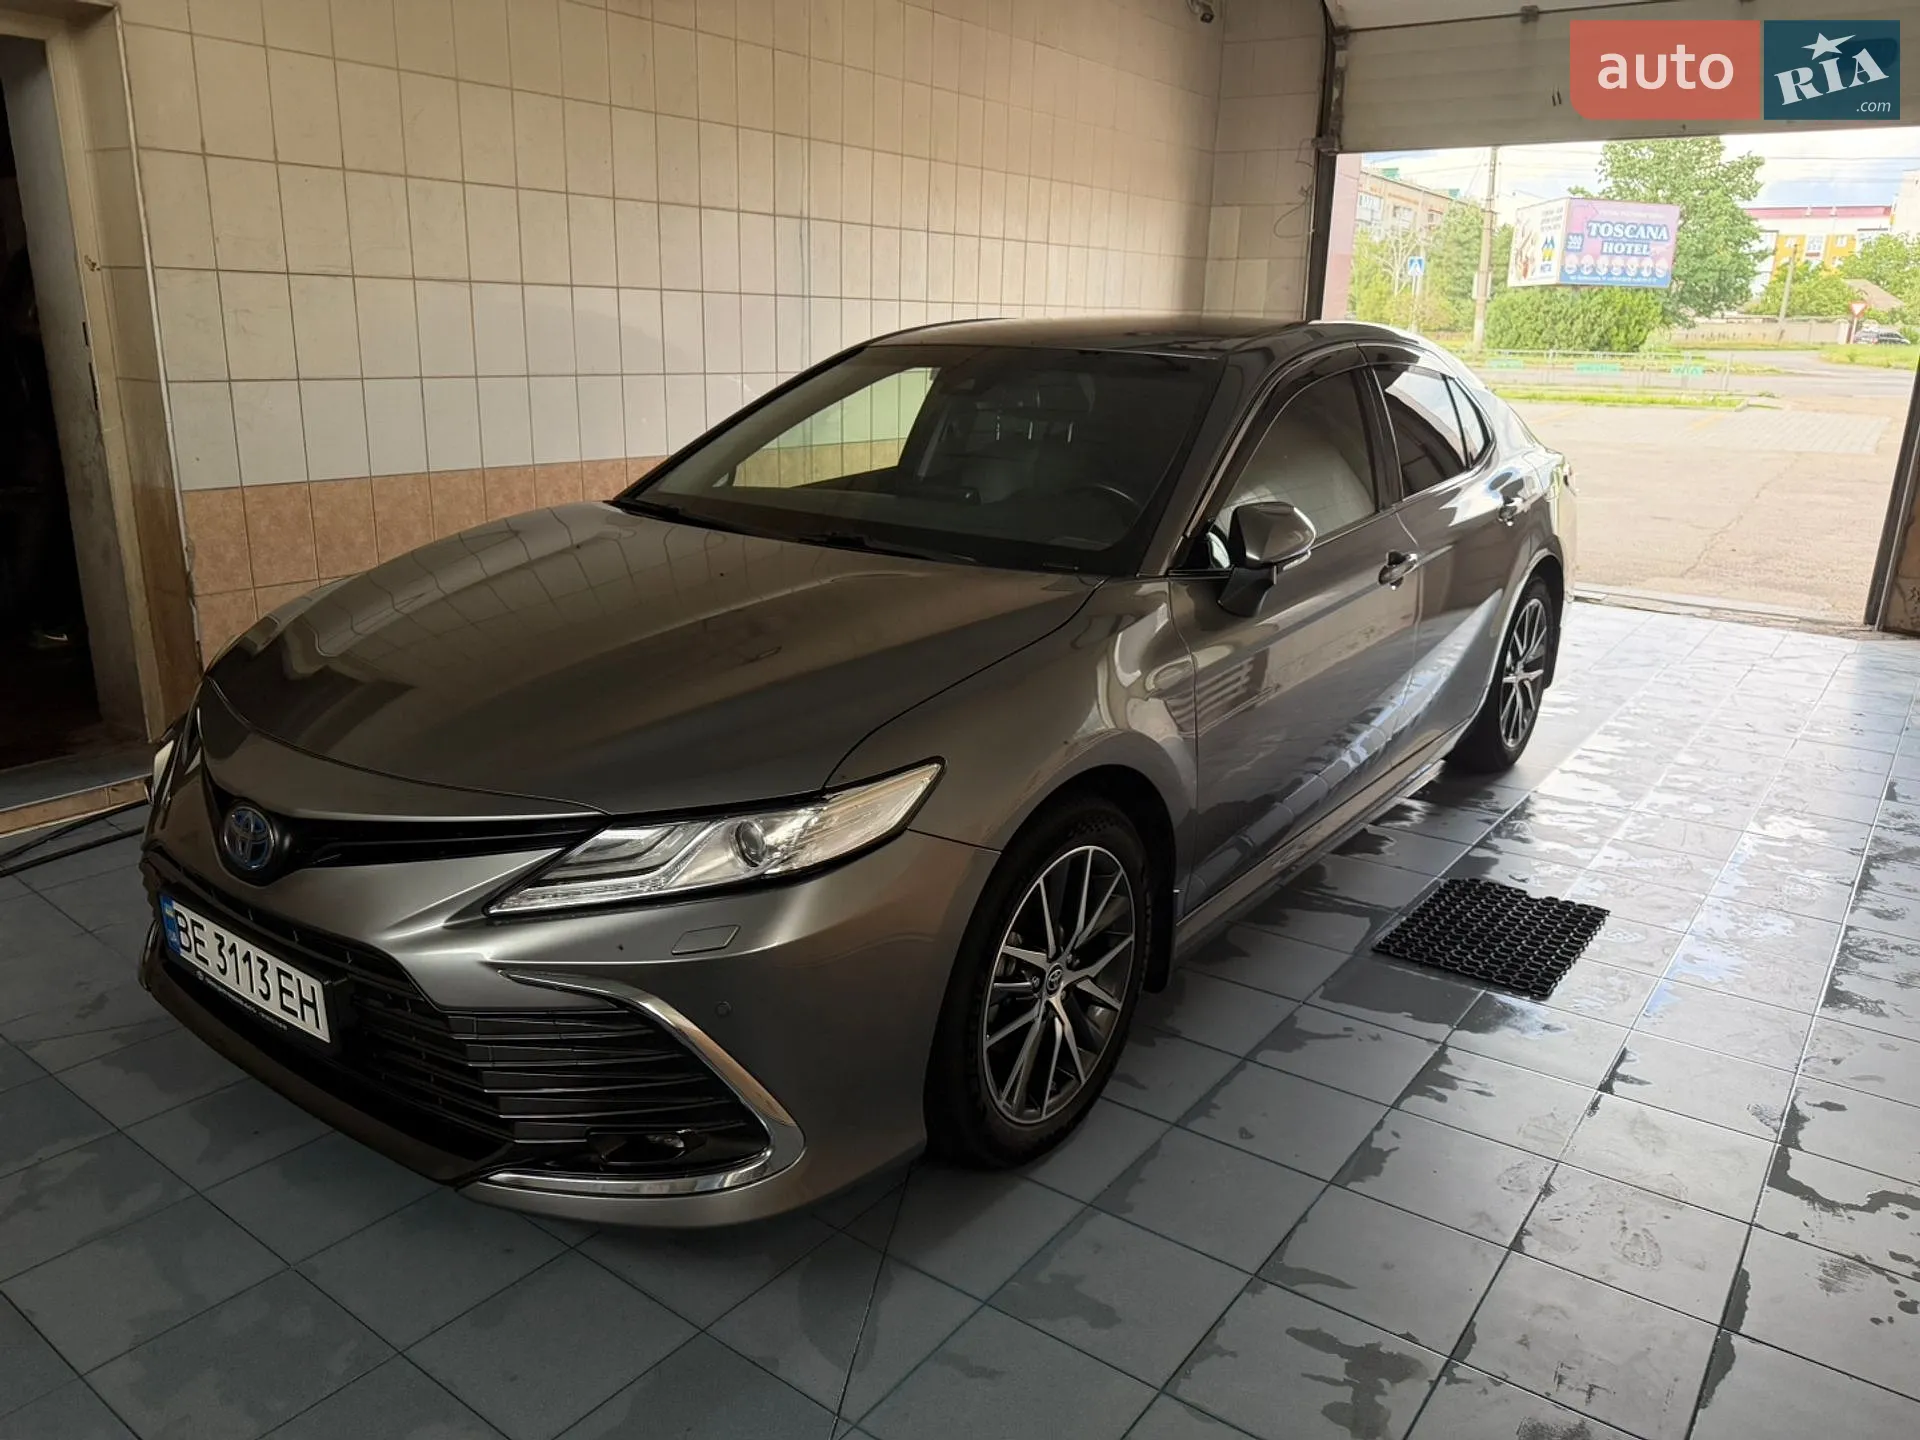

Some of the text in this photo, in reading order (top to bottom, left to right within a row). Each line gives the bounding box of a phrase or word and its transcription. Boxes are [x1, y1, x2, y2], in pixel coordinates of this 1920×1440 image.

[1588, 222, 1669, 241] TOSCANA
[1602, 241, 1650, 256] HOTEL
[174, 910, 209, 967] BE
[214, 931, 271, 1002] 3113
[276, 966, 321, 1030] EH
